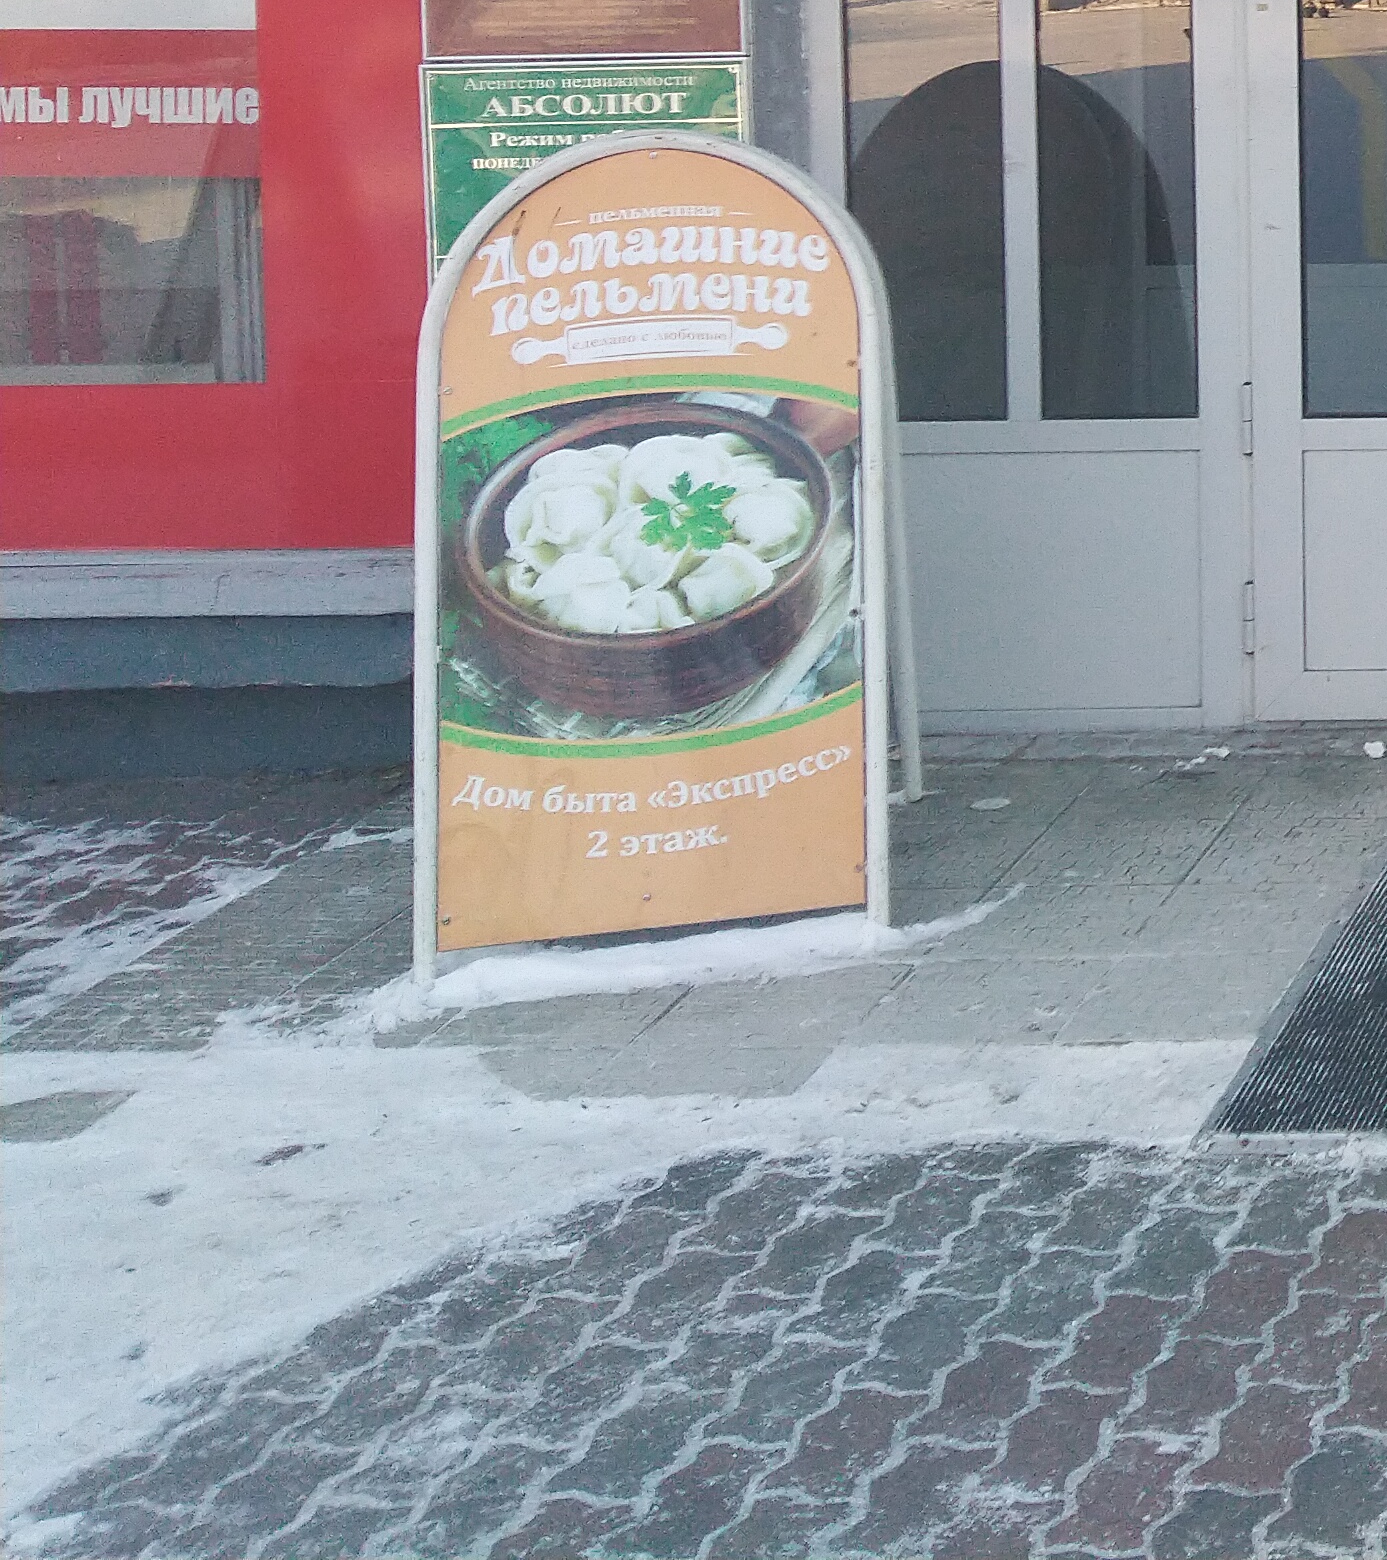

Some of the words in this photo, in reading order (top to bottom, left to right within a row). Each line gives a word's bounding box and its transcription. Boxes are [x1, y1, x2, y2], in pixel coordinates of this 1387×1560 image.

[464, 77, 556, 91] Агентство
[560, 74, 695, 89] недвижимости
[79, 86, 260, 128] лучшие
[481, 92, 687, 118] АБСОЛЮТ
[489, 132, 573, 148] Режим
[589, 206, 723, 224] пельменная
[472, 226, 829, 298] Домашние
[490, 271, 812, 336] пельмени
[452, 775, 534, 811] Дом
[542, 783, 637, 815] быта
[647, 744, 852, 809] «Экспресс»
[586, 830, 609, 859] 2
[619, 823, 728, 858] этаж.
